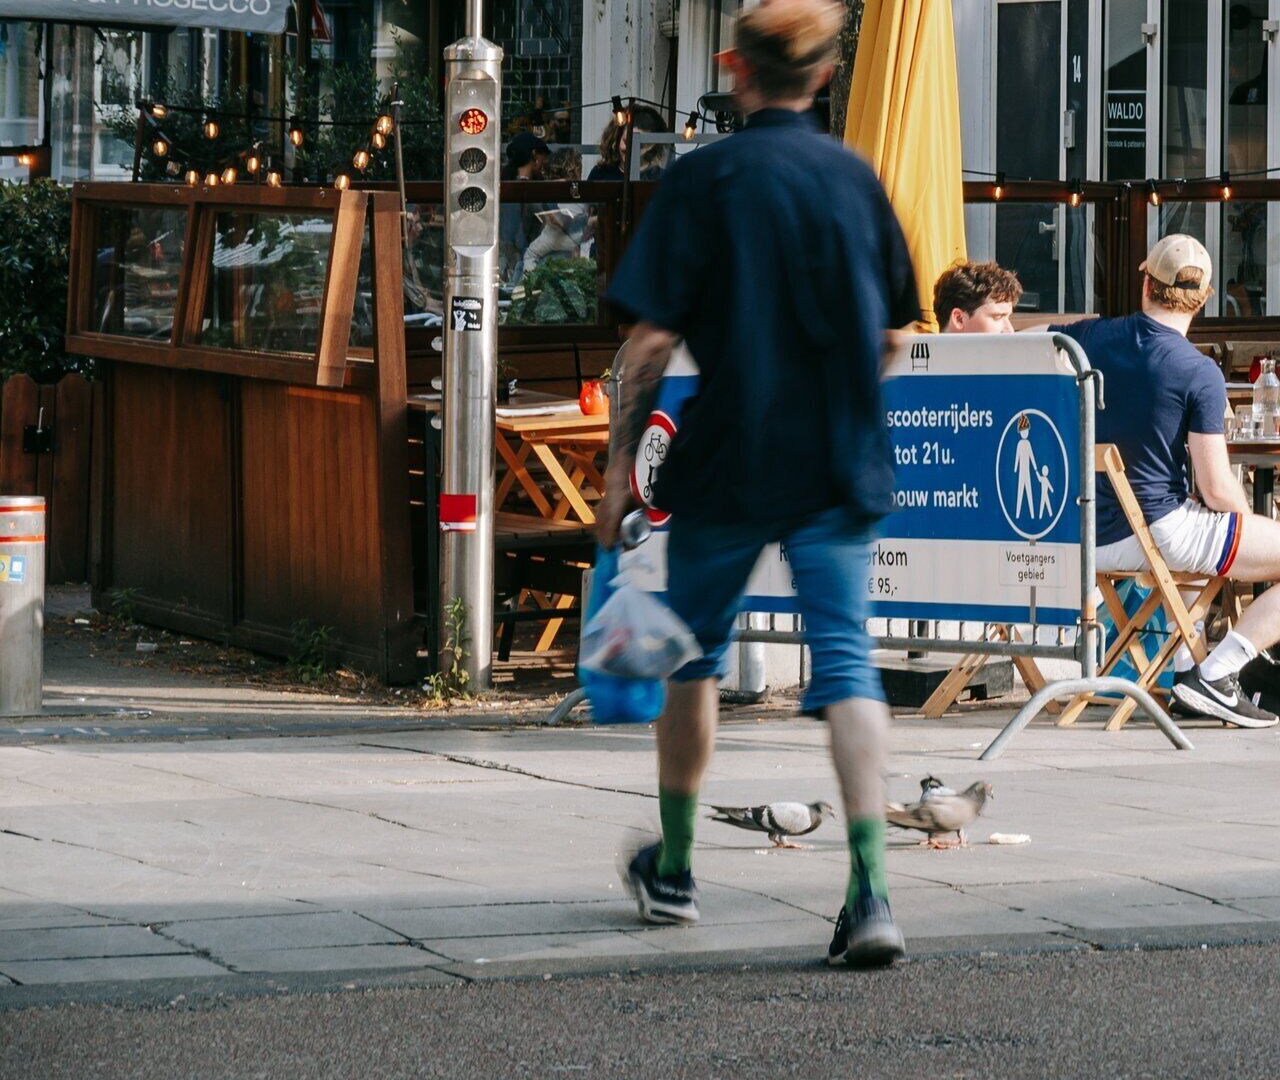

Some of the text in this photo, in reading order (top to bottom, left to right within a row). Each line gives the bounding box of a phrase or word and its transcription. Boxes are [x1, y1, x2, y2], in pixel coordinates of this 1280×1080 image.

[1072, 55, 1082, 83] 14
[1107, 102, 1144, 120] WALDO
[886, 402, 993, 434] scooterrijders
[894, 441, 955, 465] tot 21u.
[933, 483, 979, 508] markt
[1005, 551, 1056, 566] Voetgangers
[1017, 568, 1045, 582] gebied
[867, 577, 899, 596] € 95,-
